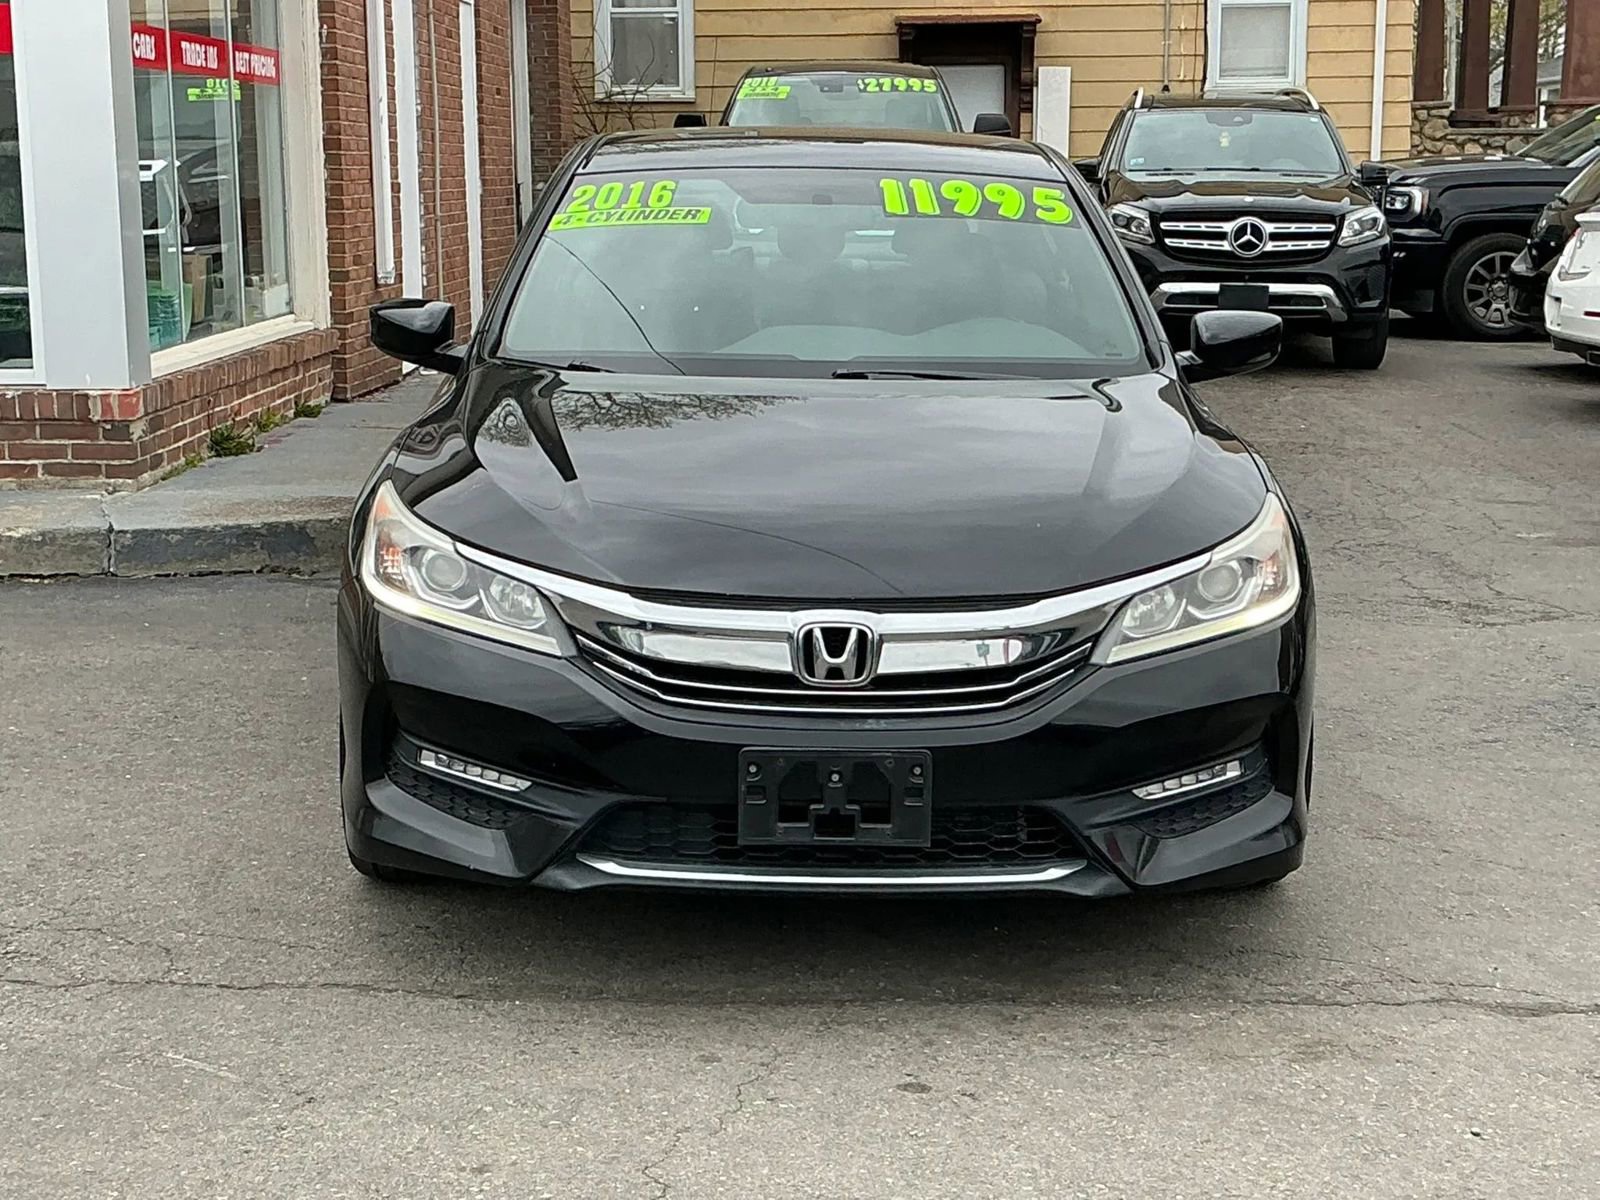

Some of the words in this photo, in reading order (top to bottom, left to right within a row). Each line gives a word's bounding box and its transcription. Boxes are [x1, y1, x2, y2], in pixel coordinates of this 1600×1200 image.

[132, 31, 156, 61] CARS
[180, 40, 206, 67] TRADE
[234, 50, 250, 74] BEST
[250, 53, 276, 78] PRICING
[856, 77, 938, 92] $27995
[566, 180, 677, 213] 2016
[879, 178, 1073, 225] 11995
[556, 208, 703, 226] 4-CYLINDER
